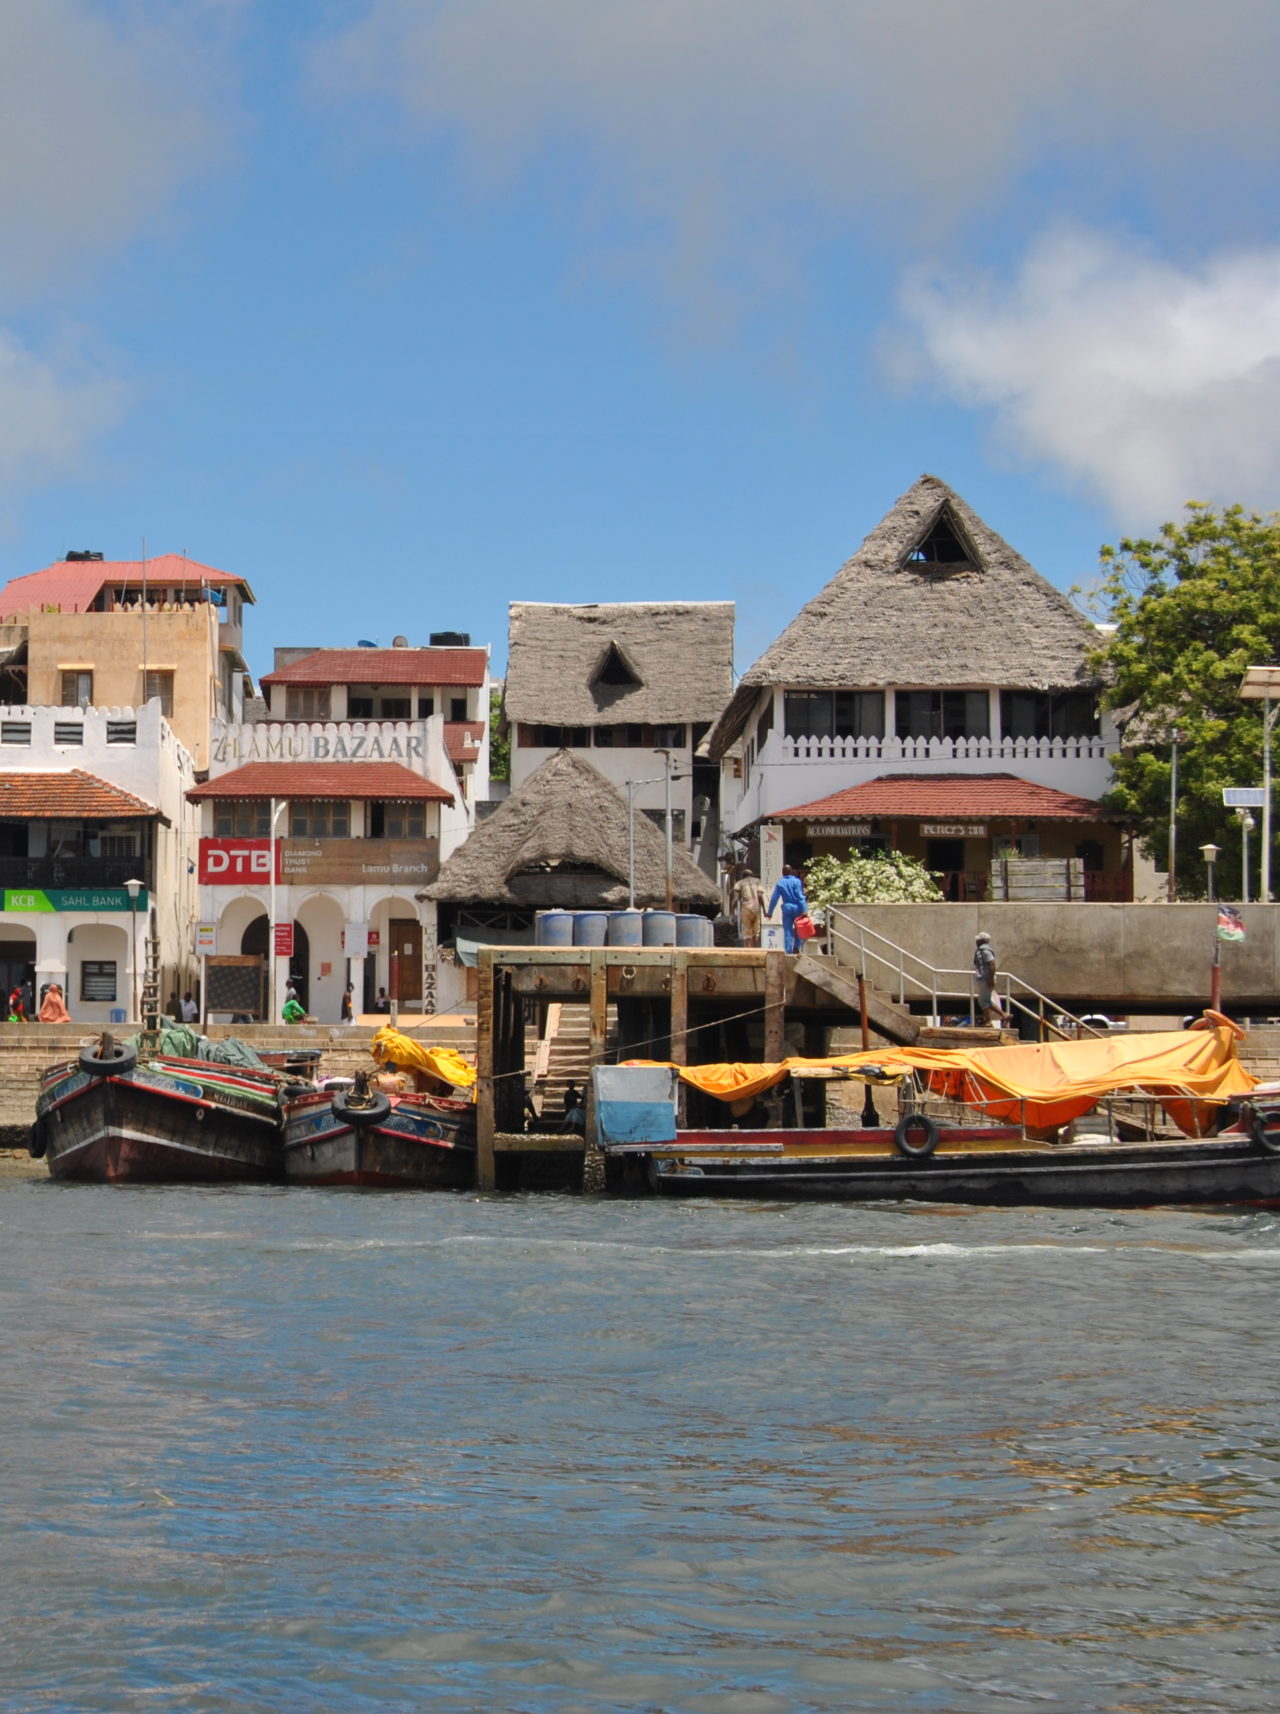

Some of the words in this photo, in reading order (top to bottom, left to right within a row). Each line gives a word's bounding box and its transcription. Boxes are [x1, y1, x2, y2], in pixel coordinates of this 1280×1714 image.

[231, 736, 304, 759] LAMU
[313, 735, 424, 759] BAZAAR
[284, 850, 323, 858] DIAMOND
[207, 849, 273, 873] DTB
[361, 863, 389, 874] Lamu
[392, 863, 428, 873] Branch
[10, 894, 35, 907] KCB
[61, 895, 89, 906] SAHL
[92, 895, 123, 906] BANK
[424, 964, 437, 1015] BAZAAR
